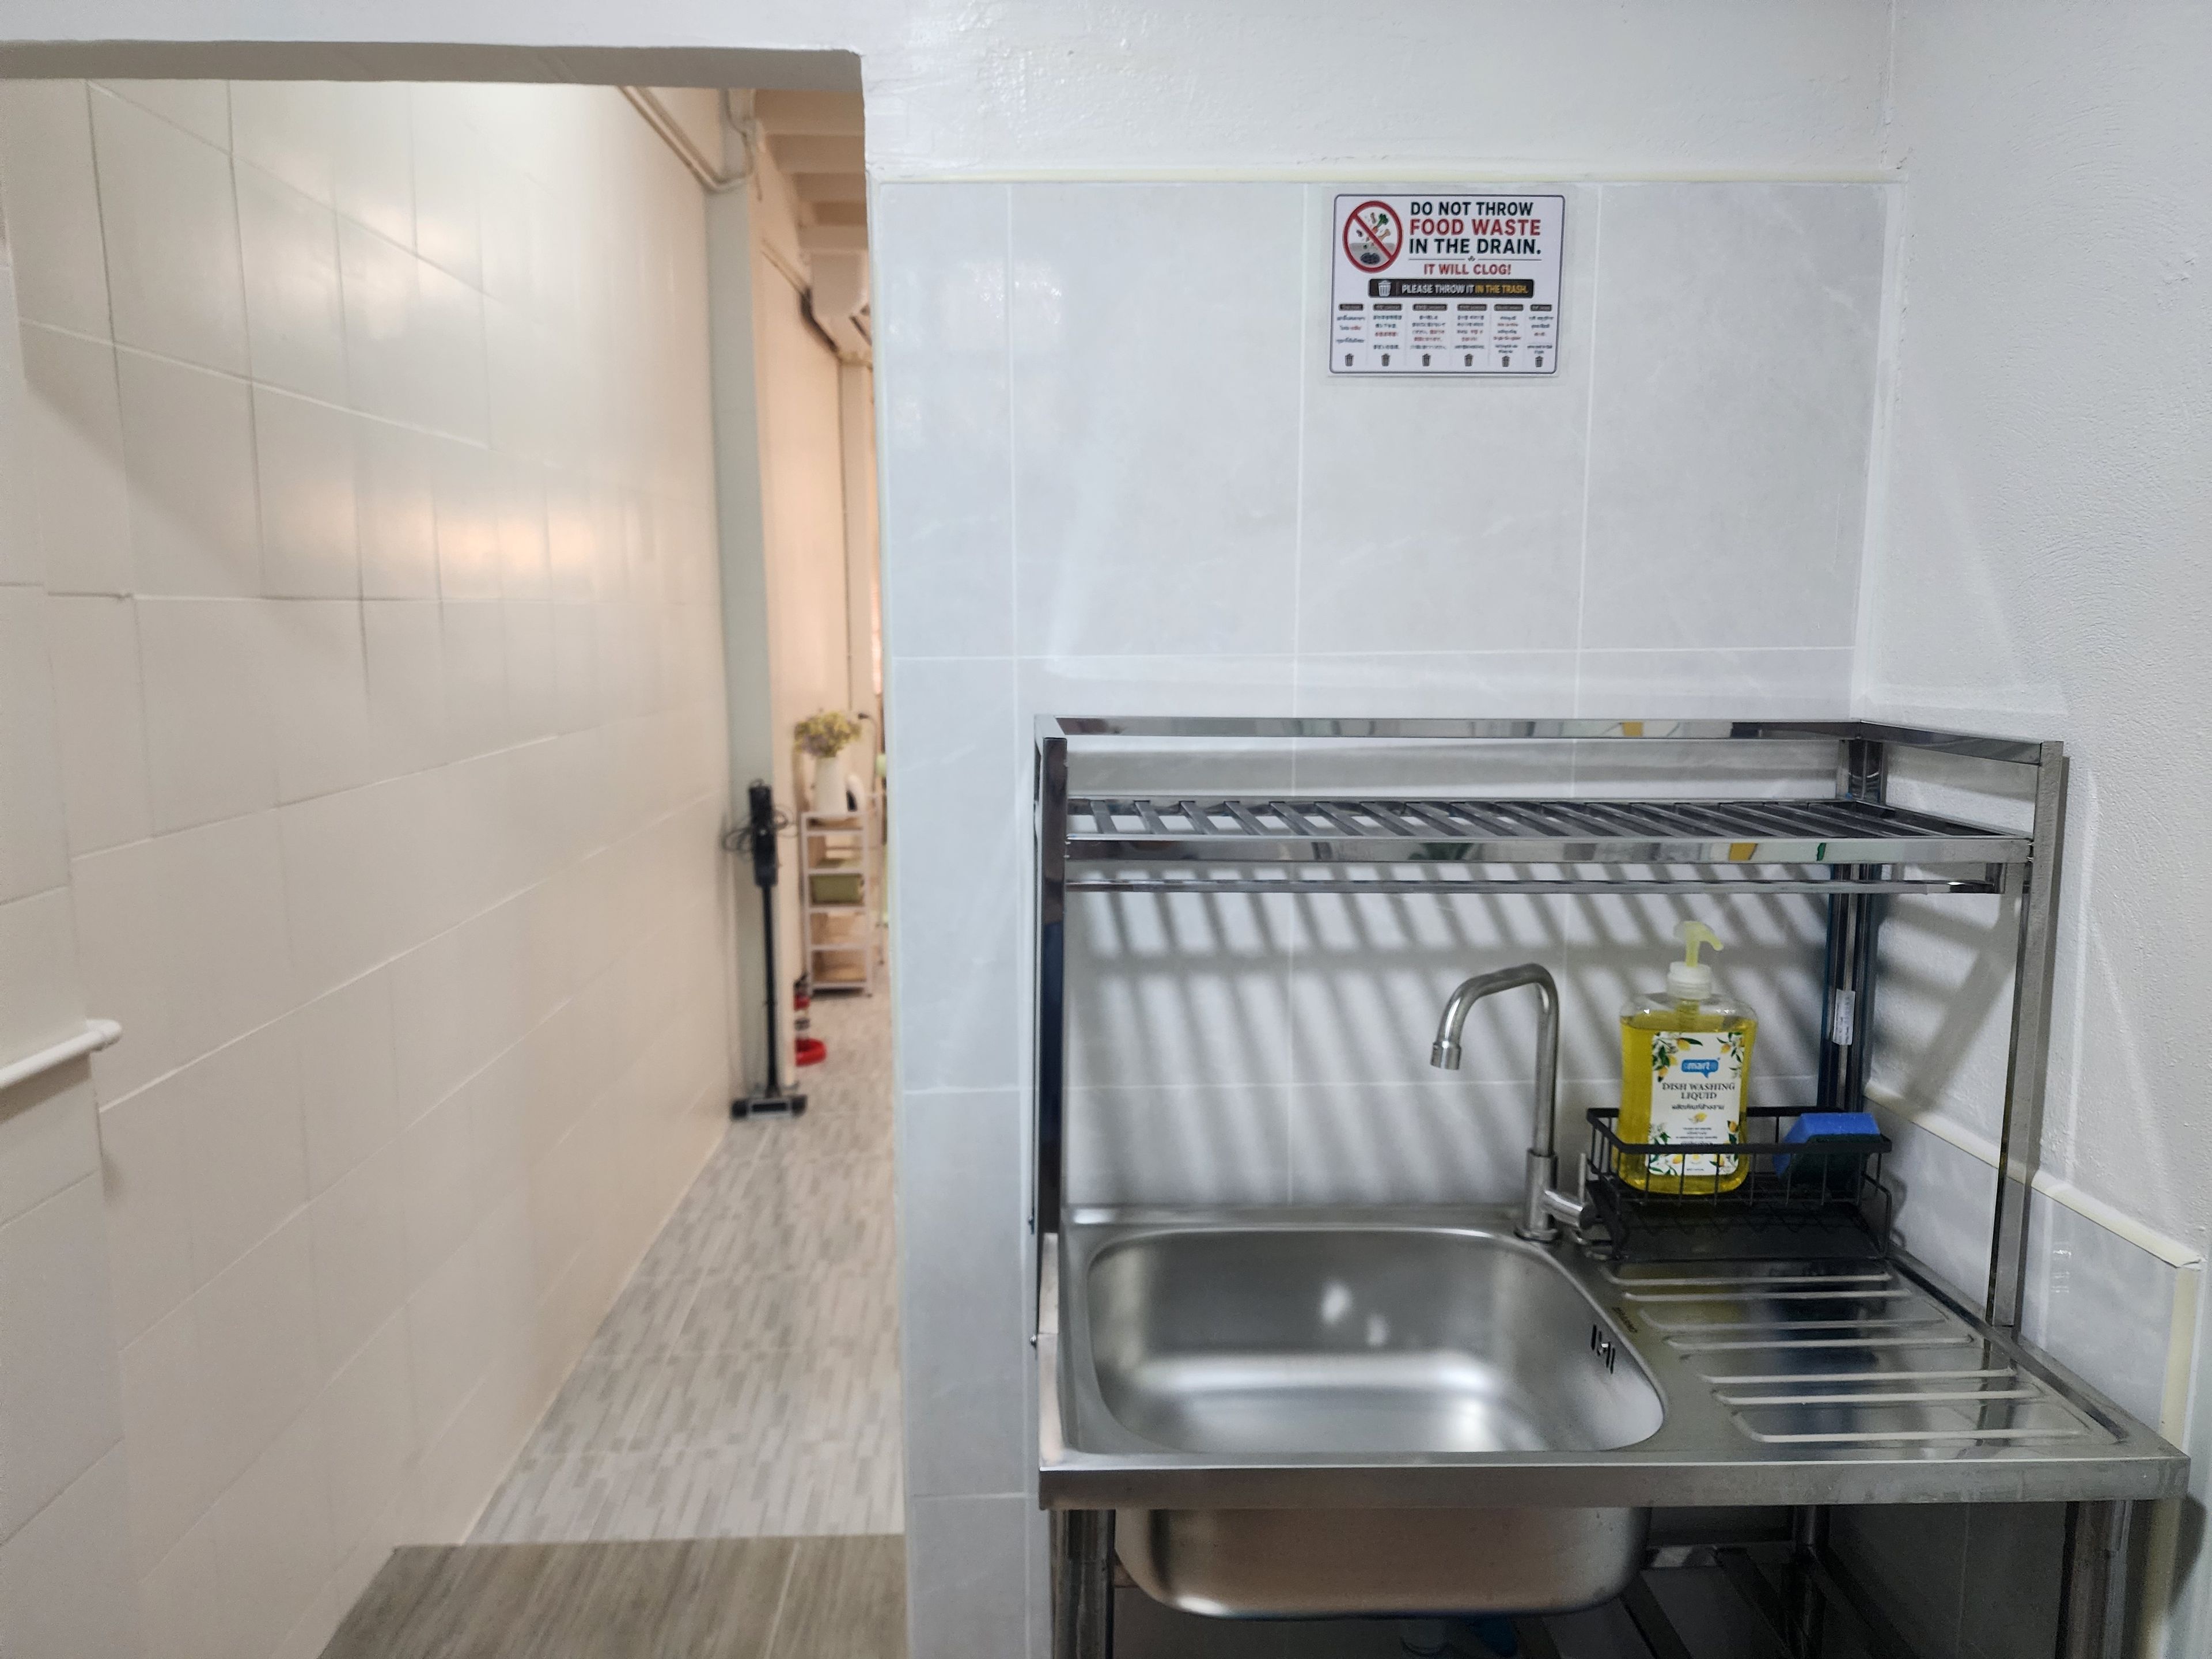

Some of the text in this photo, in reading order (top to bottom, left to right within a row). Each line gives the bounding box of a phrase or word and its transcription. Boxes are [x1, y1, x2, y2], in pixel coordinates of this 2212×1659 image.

[1411, 202, 1534, 216] DO NOT THROW
[1410, 218, 1541, 236] FOOD WASTE
[1409, 238, 1541, 255] IN THE DRAIN.
[1423, 264, 1512, 275] IT WILL CLOG!
[1402, 284, 1528, 294] PLEASE THROW IT IN THE TRASH.
[1662, 1082, 1735, 1091] DISH WASHING
[1681, 1092, 1717, 1101] LIQUID
